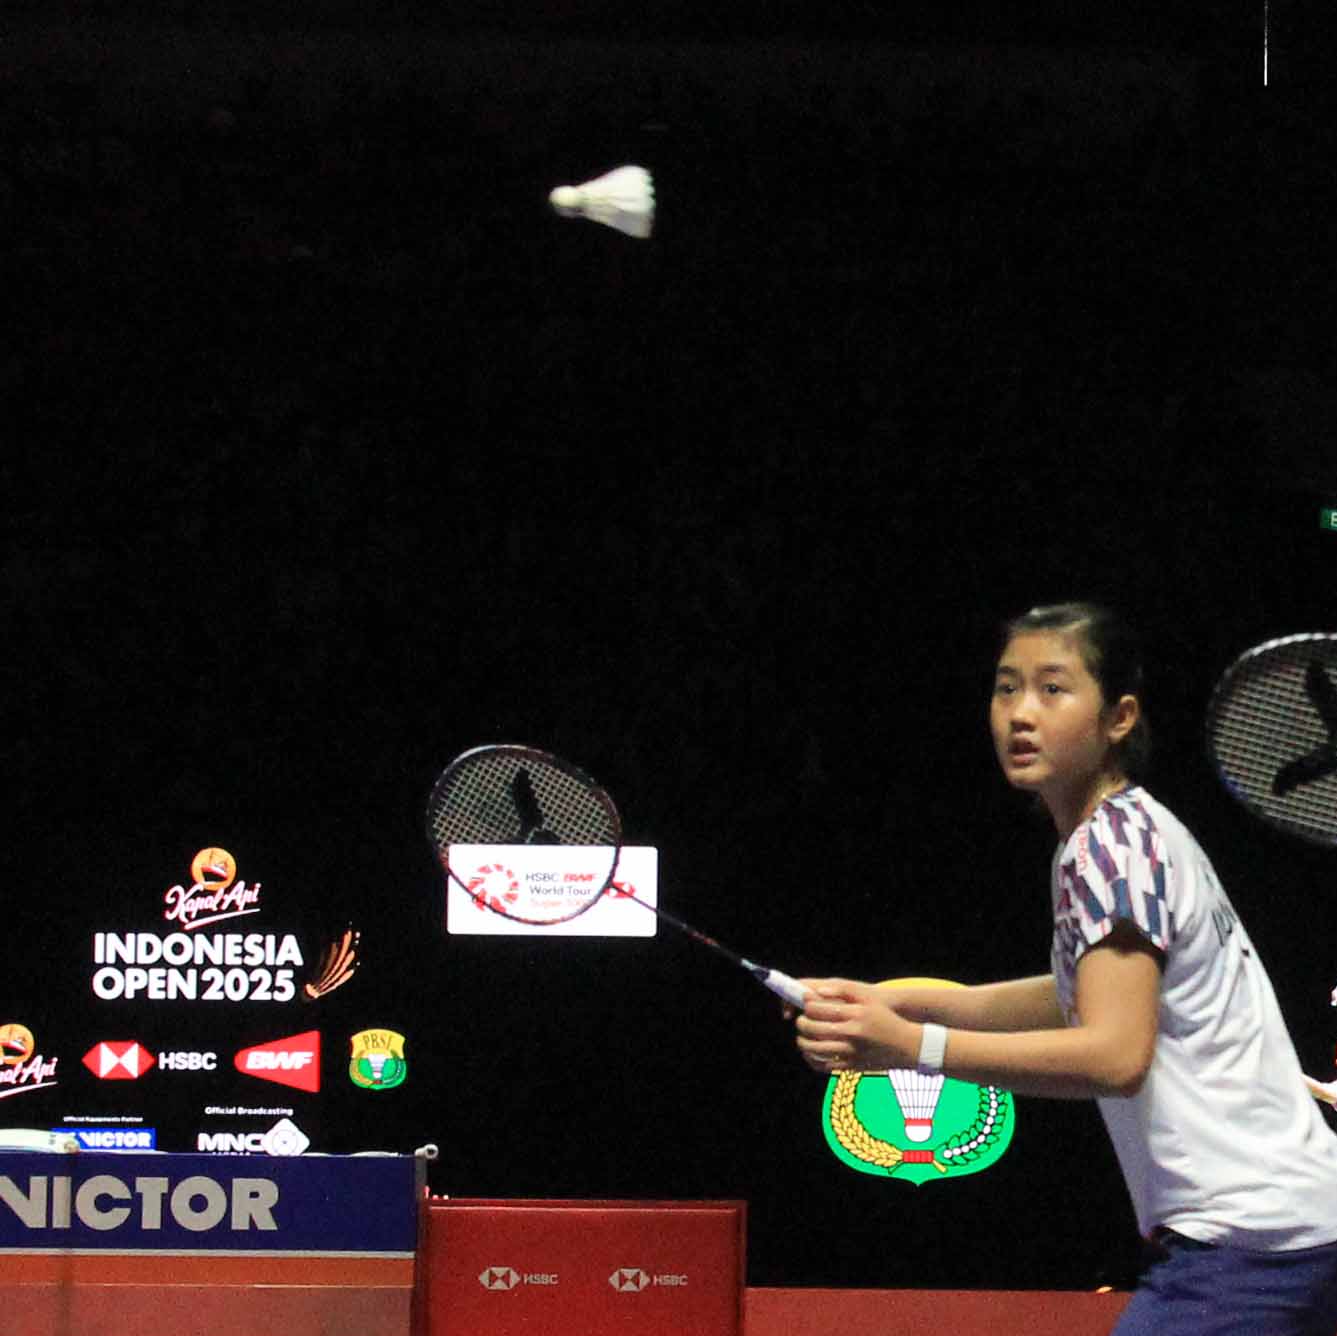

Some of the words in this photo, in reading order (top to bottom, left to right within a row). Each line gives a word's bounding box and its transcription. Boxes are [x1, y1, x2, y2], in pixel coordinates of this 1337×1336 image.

[526, 872, 560, 882] HSBC
[529, 885, 564, 896] World
[565, 886, 592, 896] Tour
[164, 884, 225, 922] Kapal
[224, 880, 262, 913] Api
[93, 932, 305, 966] INDONESIA
[92, 967, 198, 1000] OPEN
[201, 968, 296, 1002] 2025
[158, 1052, 217, 1071] HSBC
[246, 1051, 314, 1070] BWF
[205, 1106, 236, 1115] Official
[237, 1106, 294, 1116] Broadcasting
[78, 1131, 152, 1148] VICTOR
[198, 1132, 264, 1152] MNC
[0, 1175, 280, 1232] VICTOR
[523, 1273, 559, 1285] HSBC
[653, 1275, 689, 1286] HSBC
